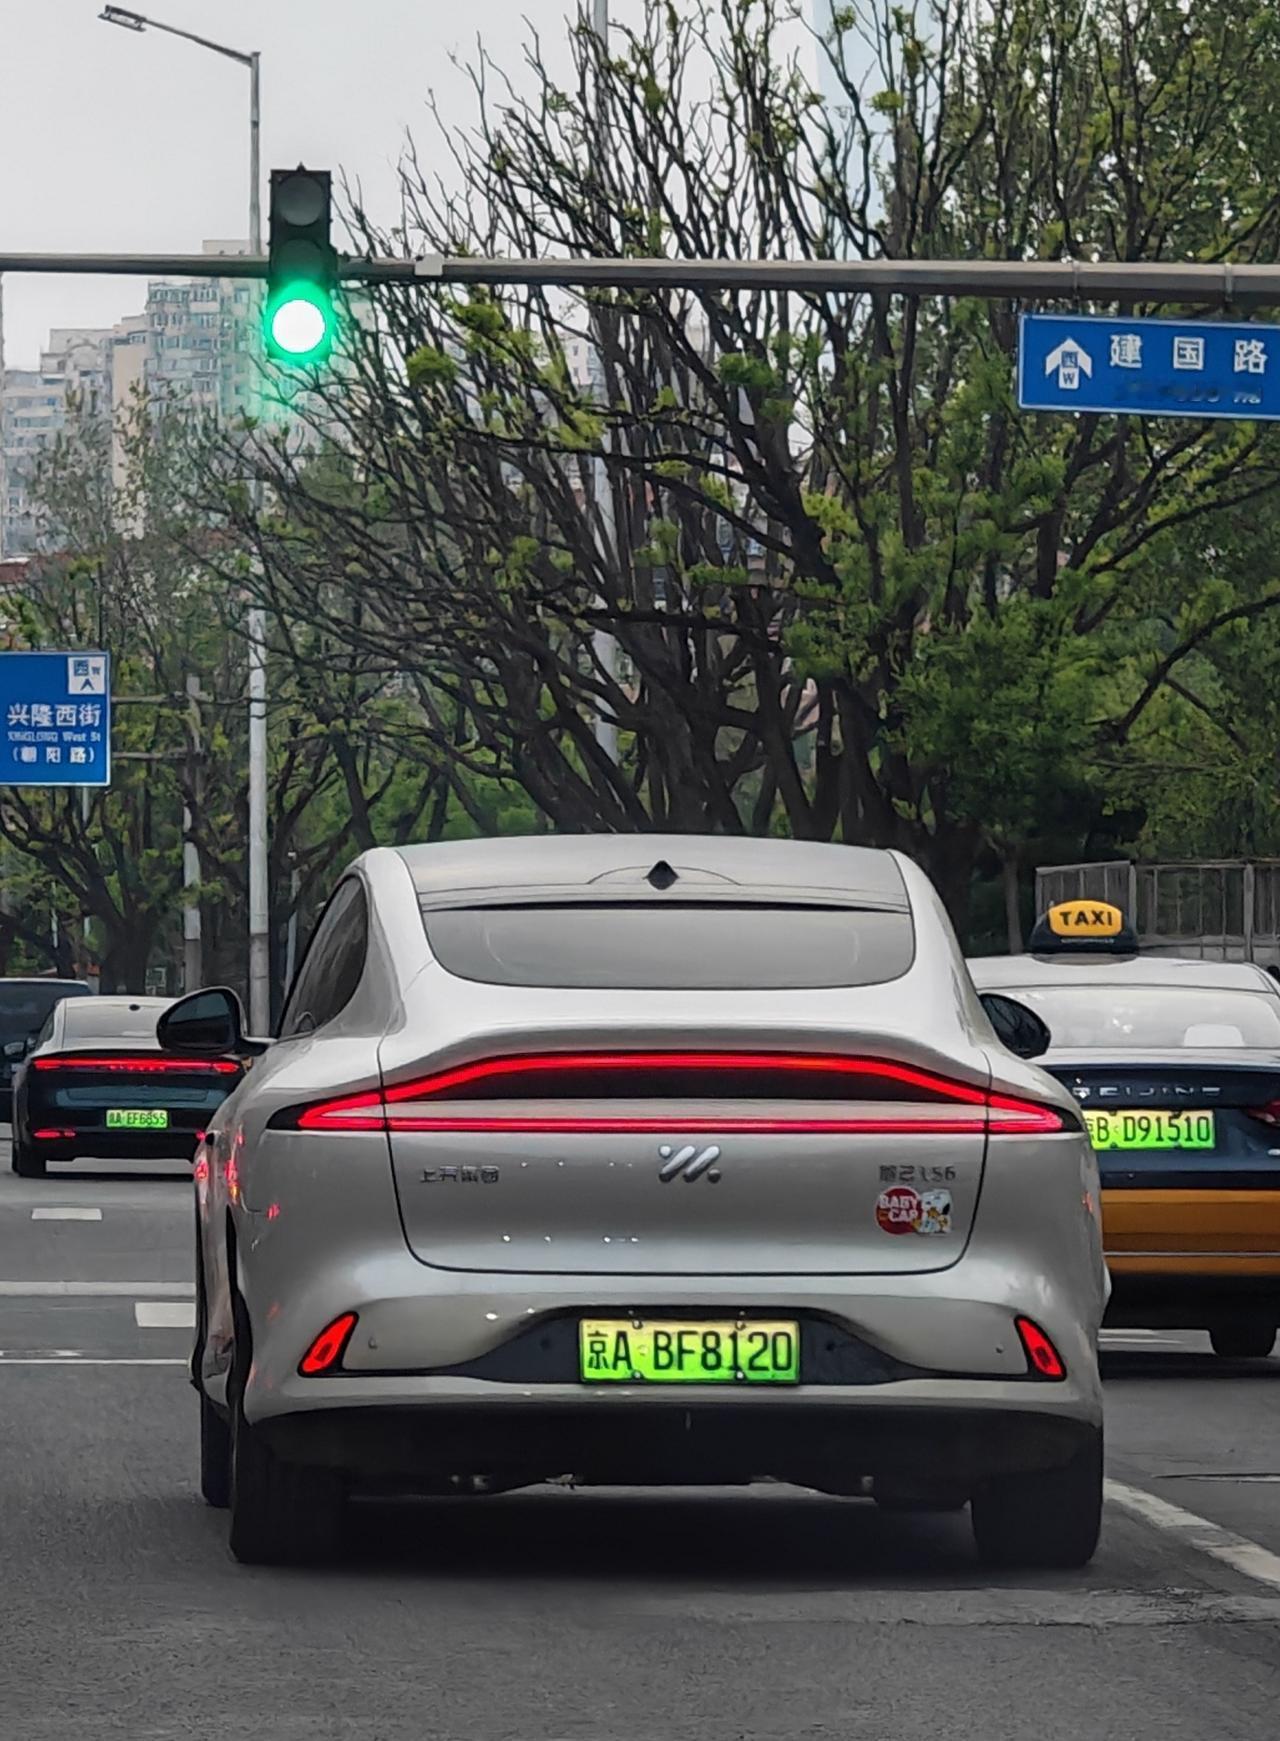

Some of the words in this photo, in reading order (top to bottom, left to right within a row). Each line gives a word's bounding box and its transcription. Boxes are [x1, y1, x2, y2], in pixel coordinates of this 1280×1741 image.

[1110, 333, 1268, 374] 建国路
[1062, 371, 1075, 385] W
[7, 702, 101, 727] 兴隆西街
[1059, 910, 1113, 927] TAXI
[1123, 1116, 1210, 1143] D91510
[587, 1330, 632, 1371] 京A
[653, 1330, 792, 1371] BF8120
